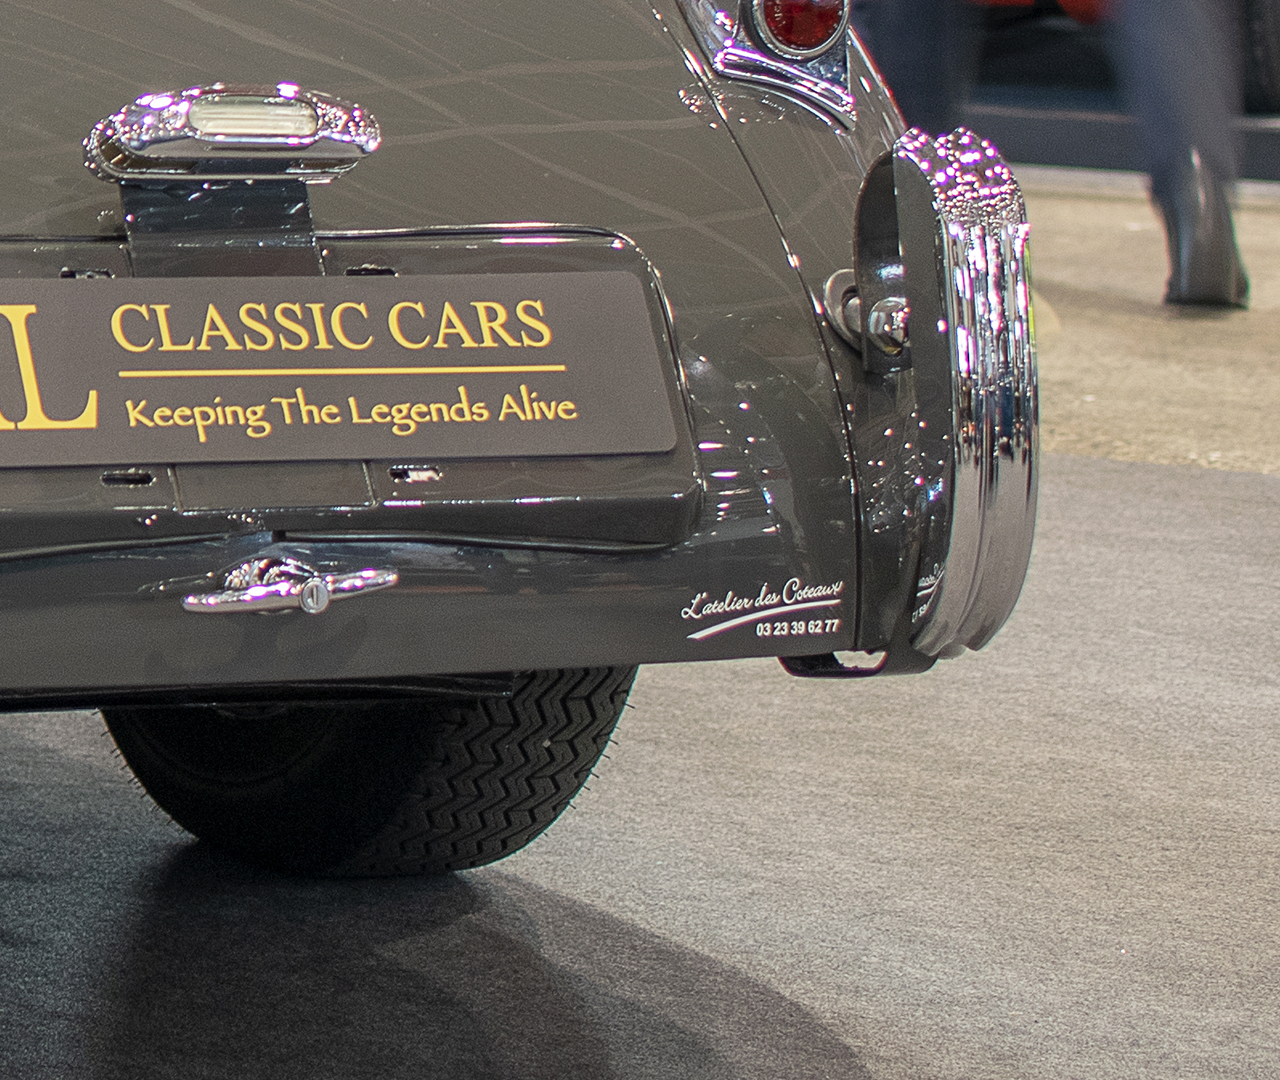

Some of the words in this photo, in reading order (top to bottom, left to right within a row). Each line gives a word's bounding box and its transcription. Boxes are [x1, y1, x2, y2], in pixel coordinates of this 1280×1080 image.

[111, 301, 373, 352] CLASSIC
[388, 299, 552, 349] CARS
[125, 397, 272, 443] Keeping
[271, 387, 341, 424] The
[347, 385, 489, 436] Legends
[498, 383, 578, 421] Alive
[681, 590, 754, 619] L'atelier
[754, 582, 781, 606] des
[782, 577, 844, 604] Coteaux
[756, 622, 771, 637] 03
[773, 622, 788, 636] 23
[790, 620, 805, 635] 39
[807, 620, 822, 634] 62
[824, 619, 839, 633] 77
